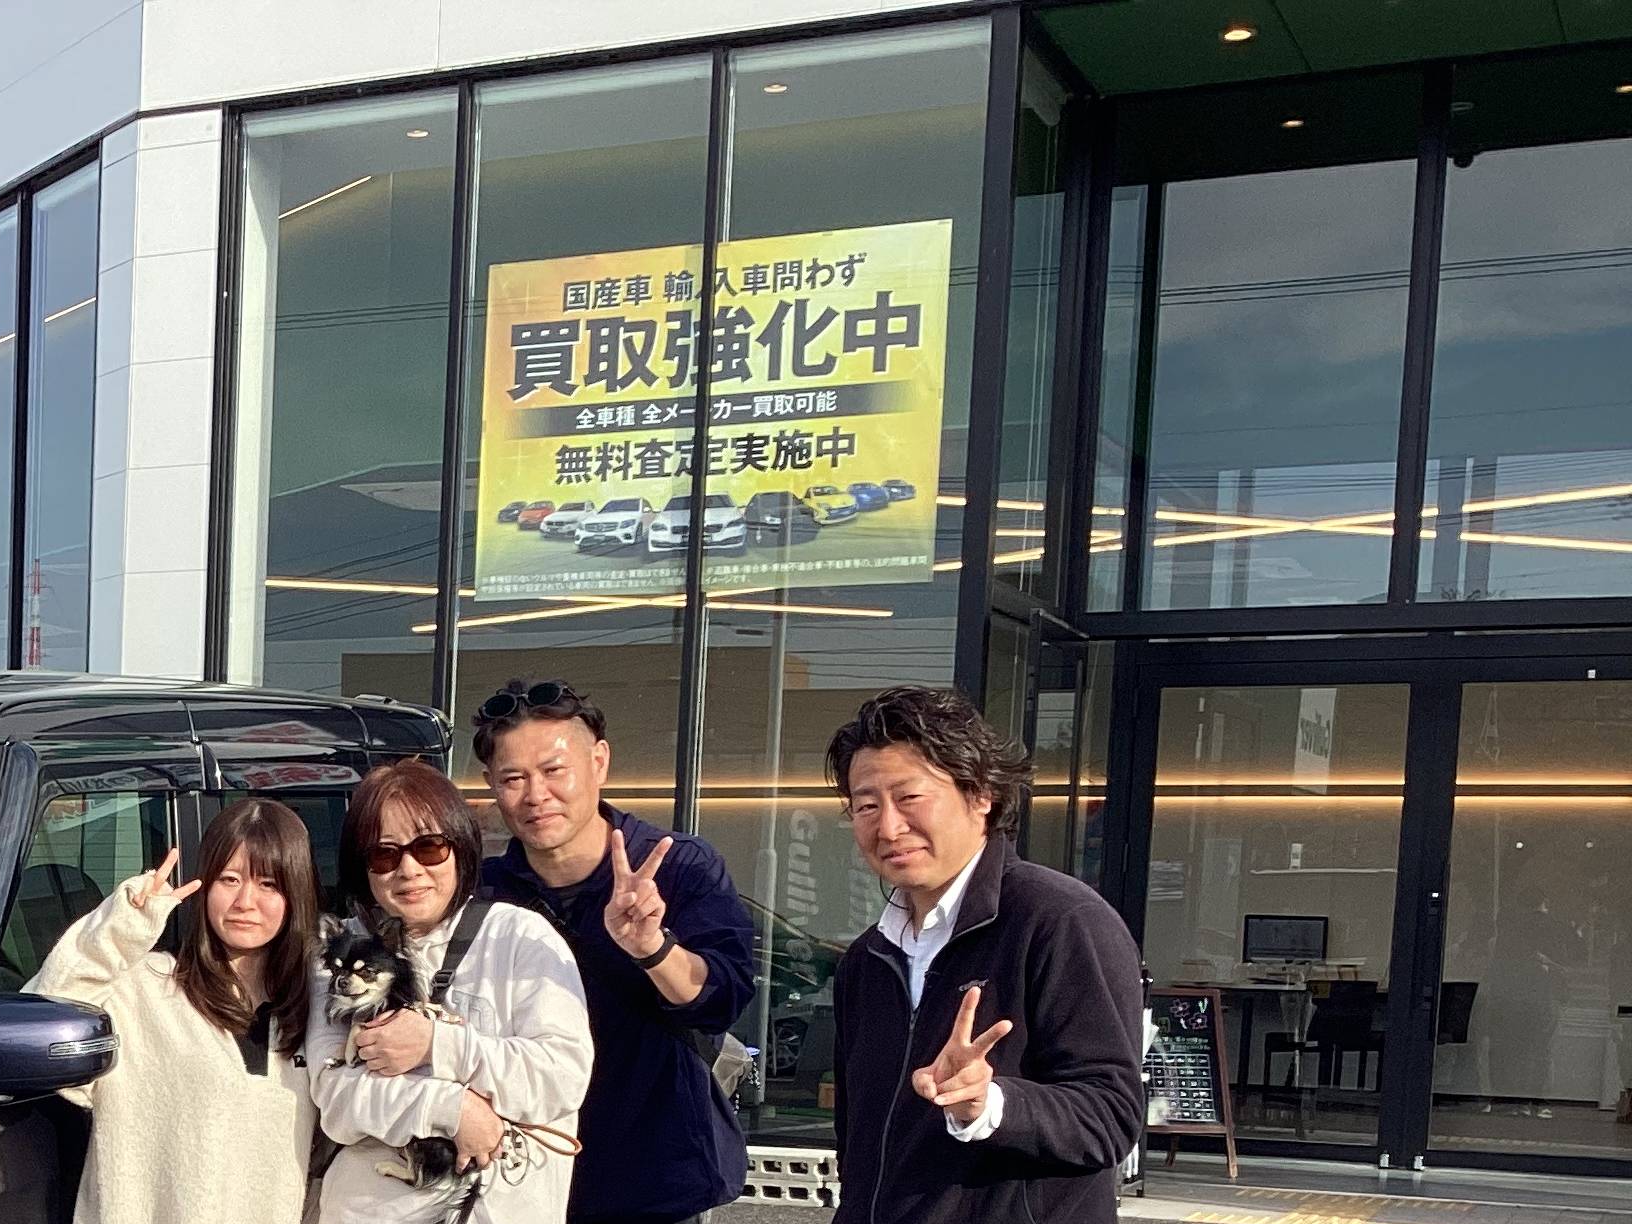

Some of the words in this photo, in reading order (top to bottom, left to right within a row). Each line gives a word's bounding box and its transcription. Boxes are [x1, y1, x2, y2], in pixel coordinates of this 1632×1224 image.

[563, 273, 653, 312] 国産車
[506, 290, 923, 401] 買取強化中
[575, 406, 635, 429] 全車種
[555, 426, 856, 485] 無料査定実施中
